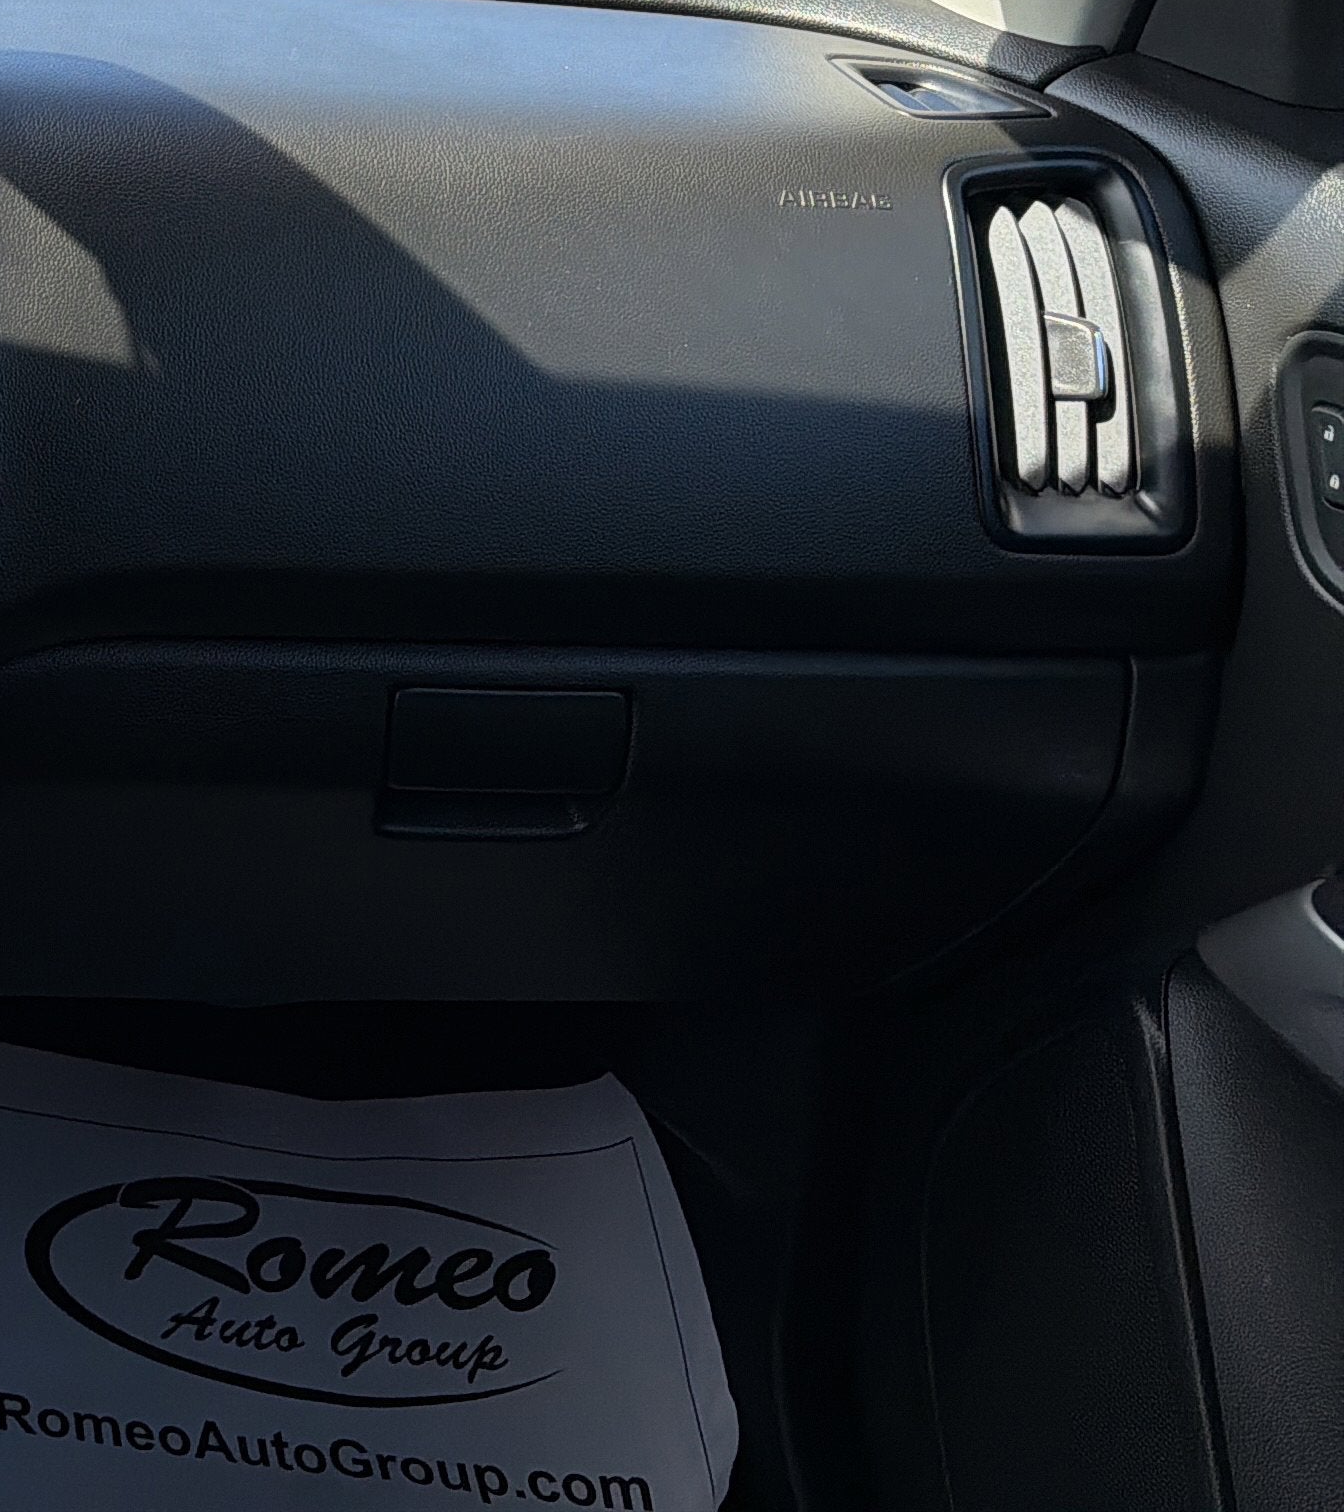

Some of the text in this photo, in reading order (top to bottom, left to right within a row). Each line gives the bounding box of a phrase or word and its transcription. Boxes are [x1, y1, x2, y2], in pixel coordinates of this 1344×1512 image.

[778, 189, 894, 211] AIRBAG
[119, 1176, 558, 1313] Romeo
[162, 1296, 508, 1384] Auto Group
